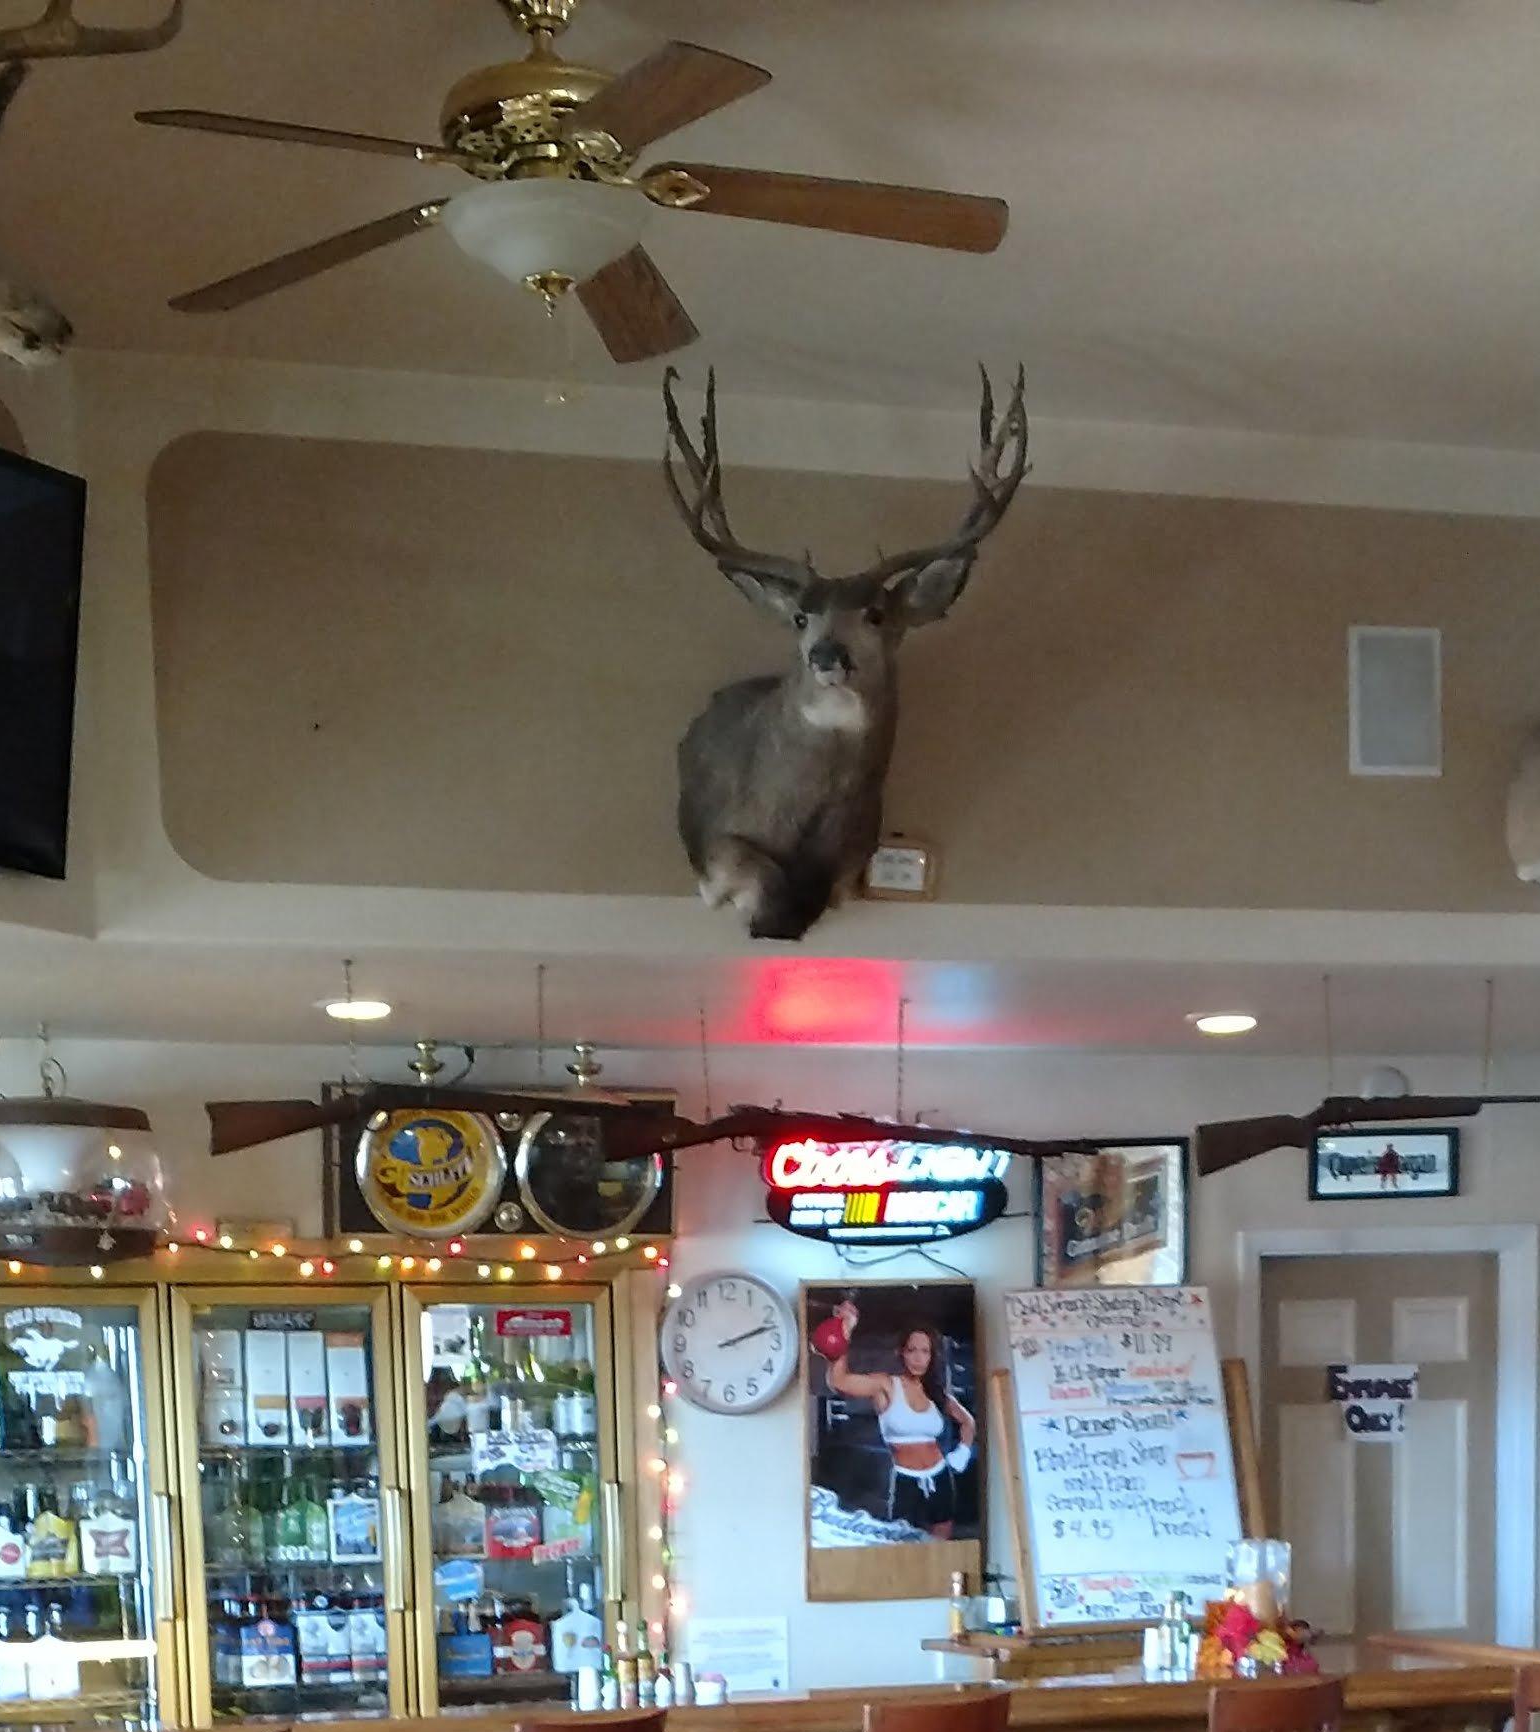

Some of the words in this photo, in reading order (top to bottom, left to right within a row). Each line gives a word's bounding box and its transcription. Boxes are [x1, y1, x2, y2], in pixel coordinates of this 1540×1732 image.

[718, 1281, 737, 1301] 12
[677, 1308, 695, 1329] 10
[762, 1304, 775, 1325] 2
[673, 1334, 687, 1354] 9
[769, 1332, 782, 1352] 3
[683, 1360, 695, 1380] 8
[762, 1358, 774, 1376] 4
[700, 1379, 712, 1400] 7
[723, 1384, 736, 1403] 6
[746, 1377, 759, 1397] 5
